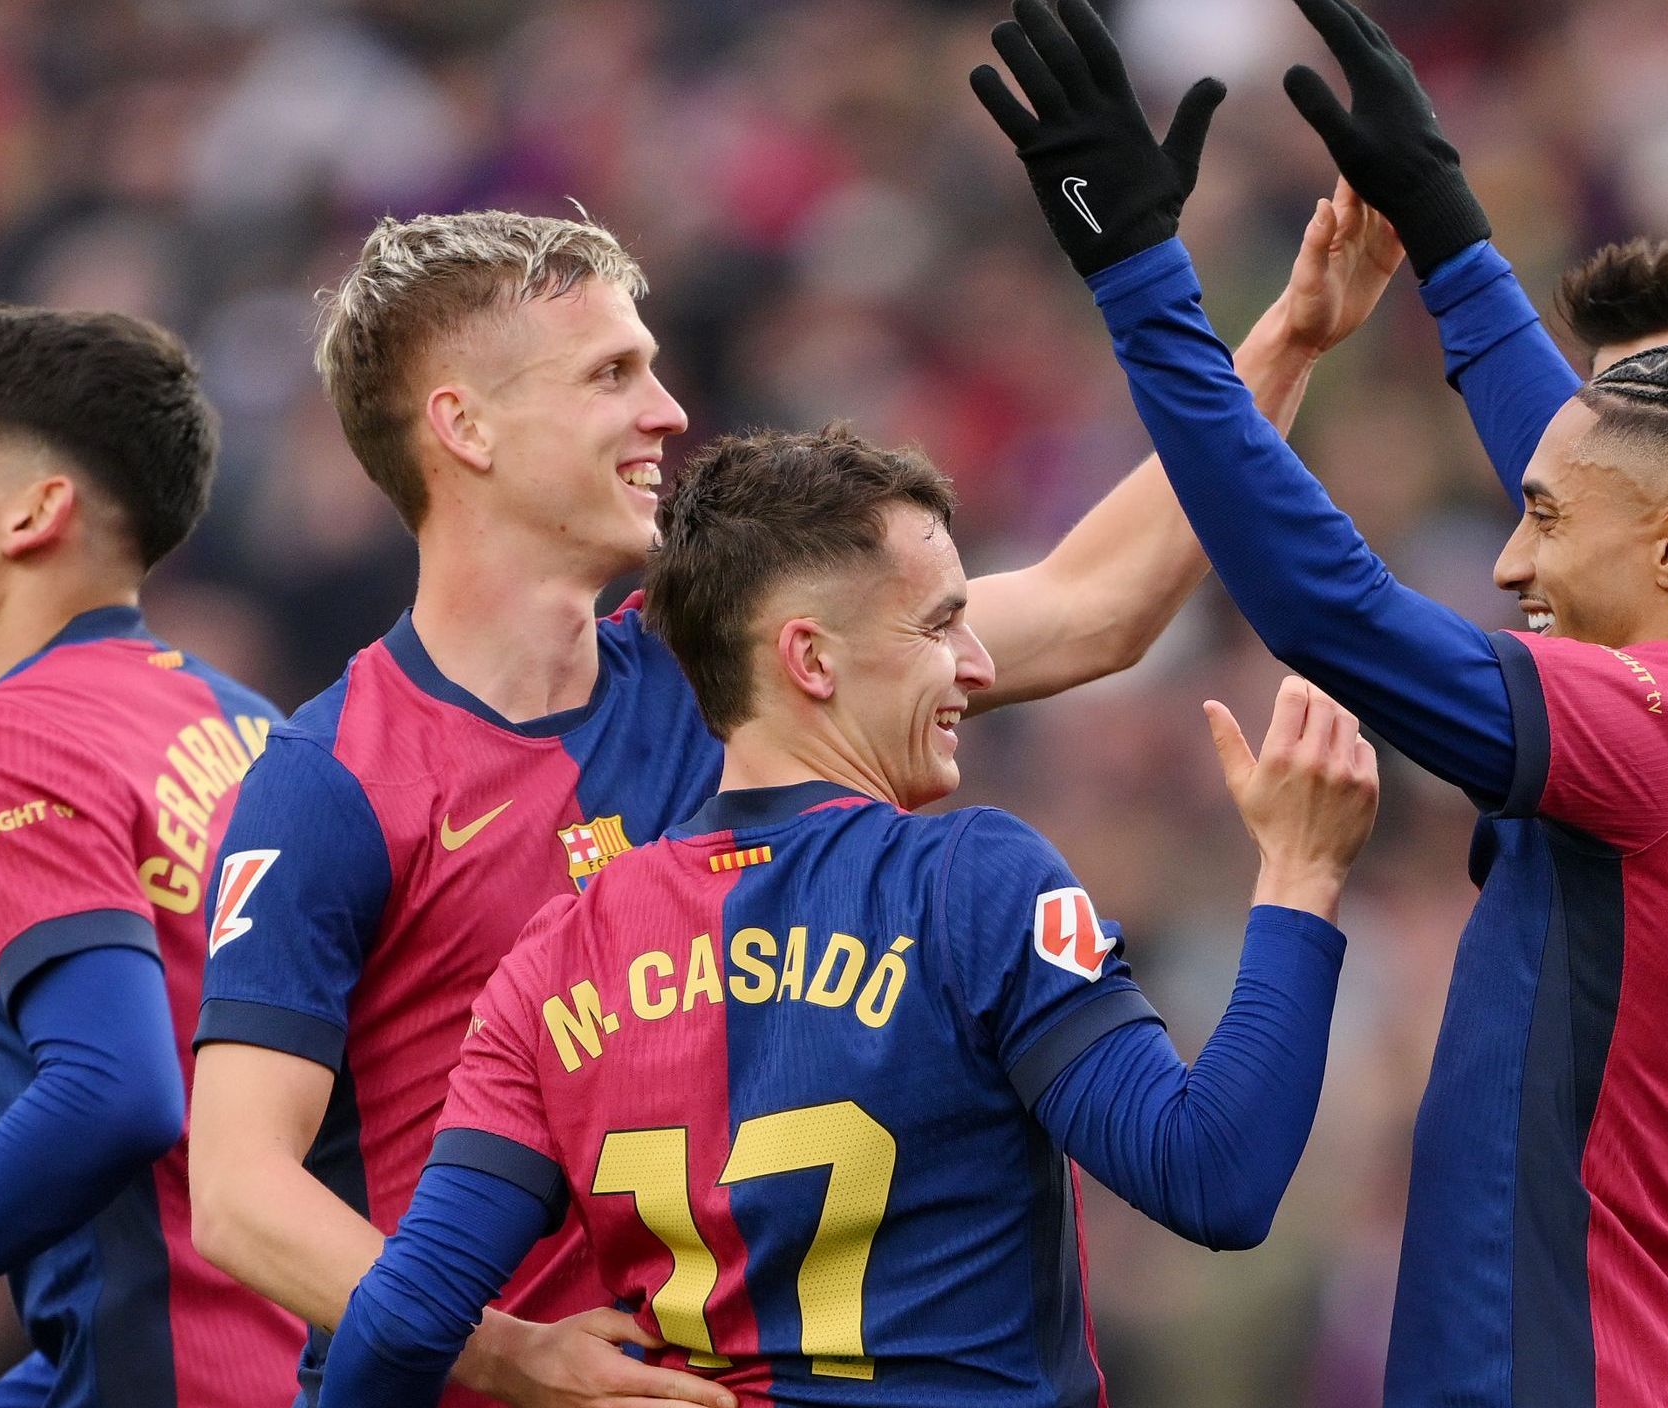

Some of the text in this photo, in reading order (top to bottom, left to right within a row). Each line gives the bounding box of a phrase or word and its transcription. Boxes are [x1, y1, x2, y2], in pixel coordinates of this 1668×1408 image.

[1646, 690, 1663, 715] tv
[541, 925, 916, 1074] M. CASADÓ
[589, 1099, 897, 1381] 17
